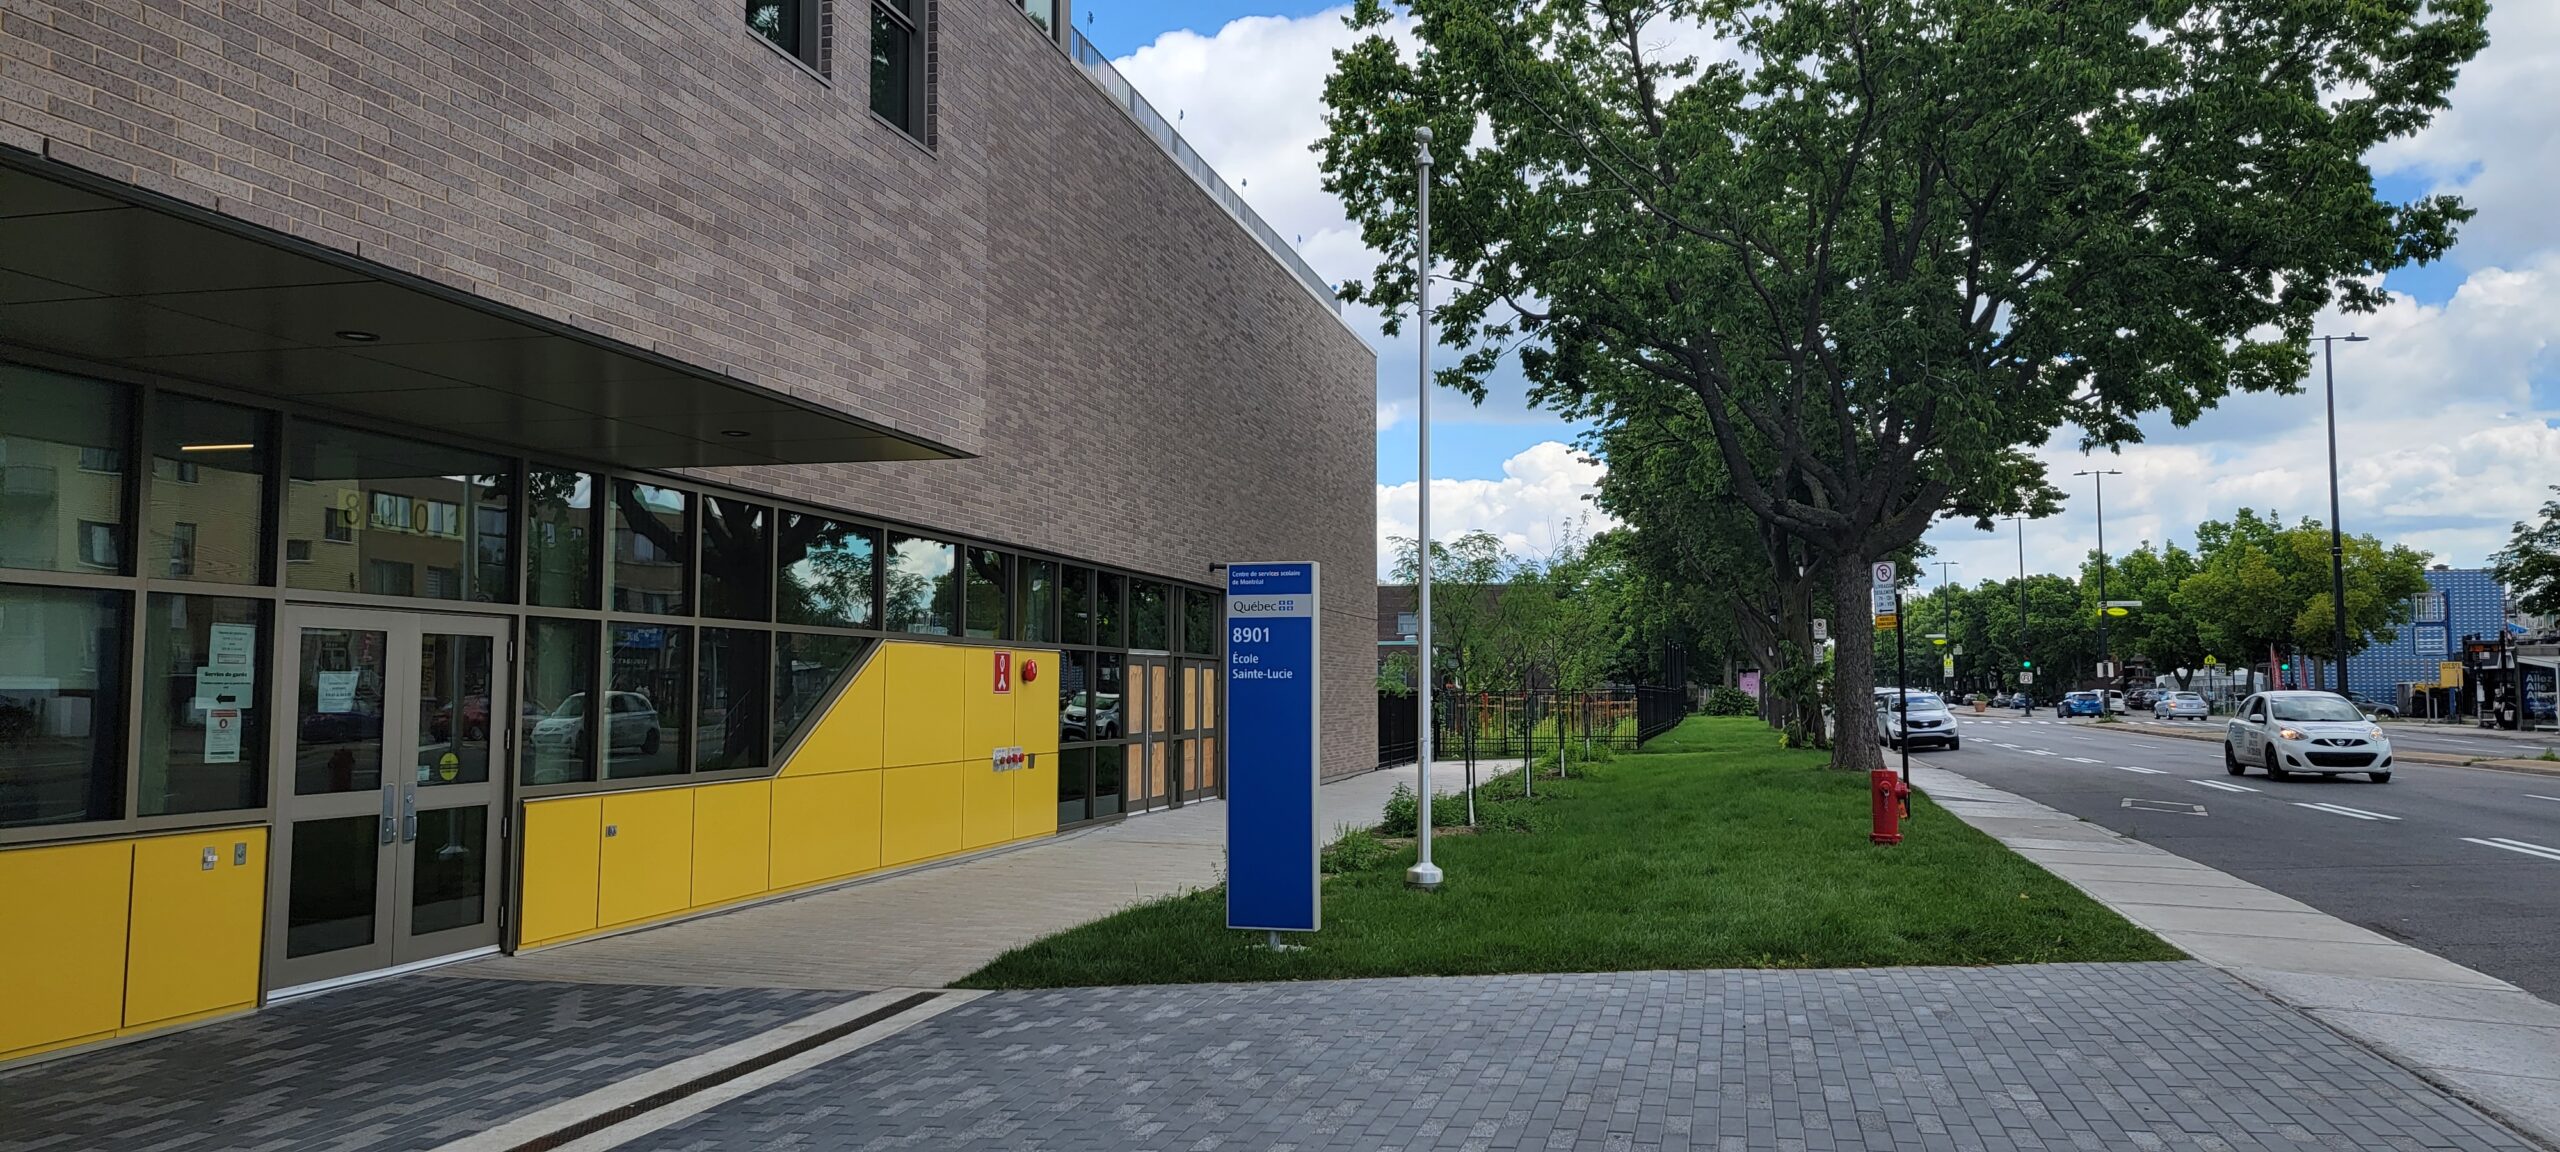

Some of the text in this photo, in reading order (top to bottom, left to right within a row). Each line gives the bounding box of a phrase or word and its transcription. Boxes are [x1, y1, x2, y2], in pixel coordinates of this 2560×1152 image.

[1233, 600, 1277, 614] Québec
[1232, 627, 1270, 643] 8901
[1232, 651, 1259, 664] École
[1232, 668, 1293, 679] Sainte-Lucie
